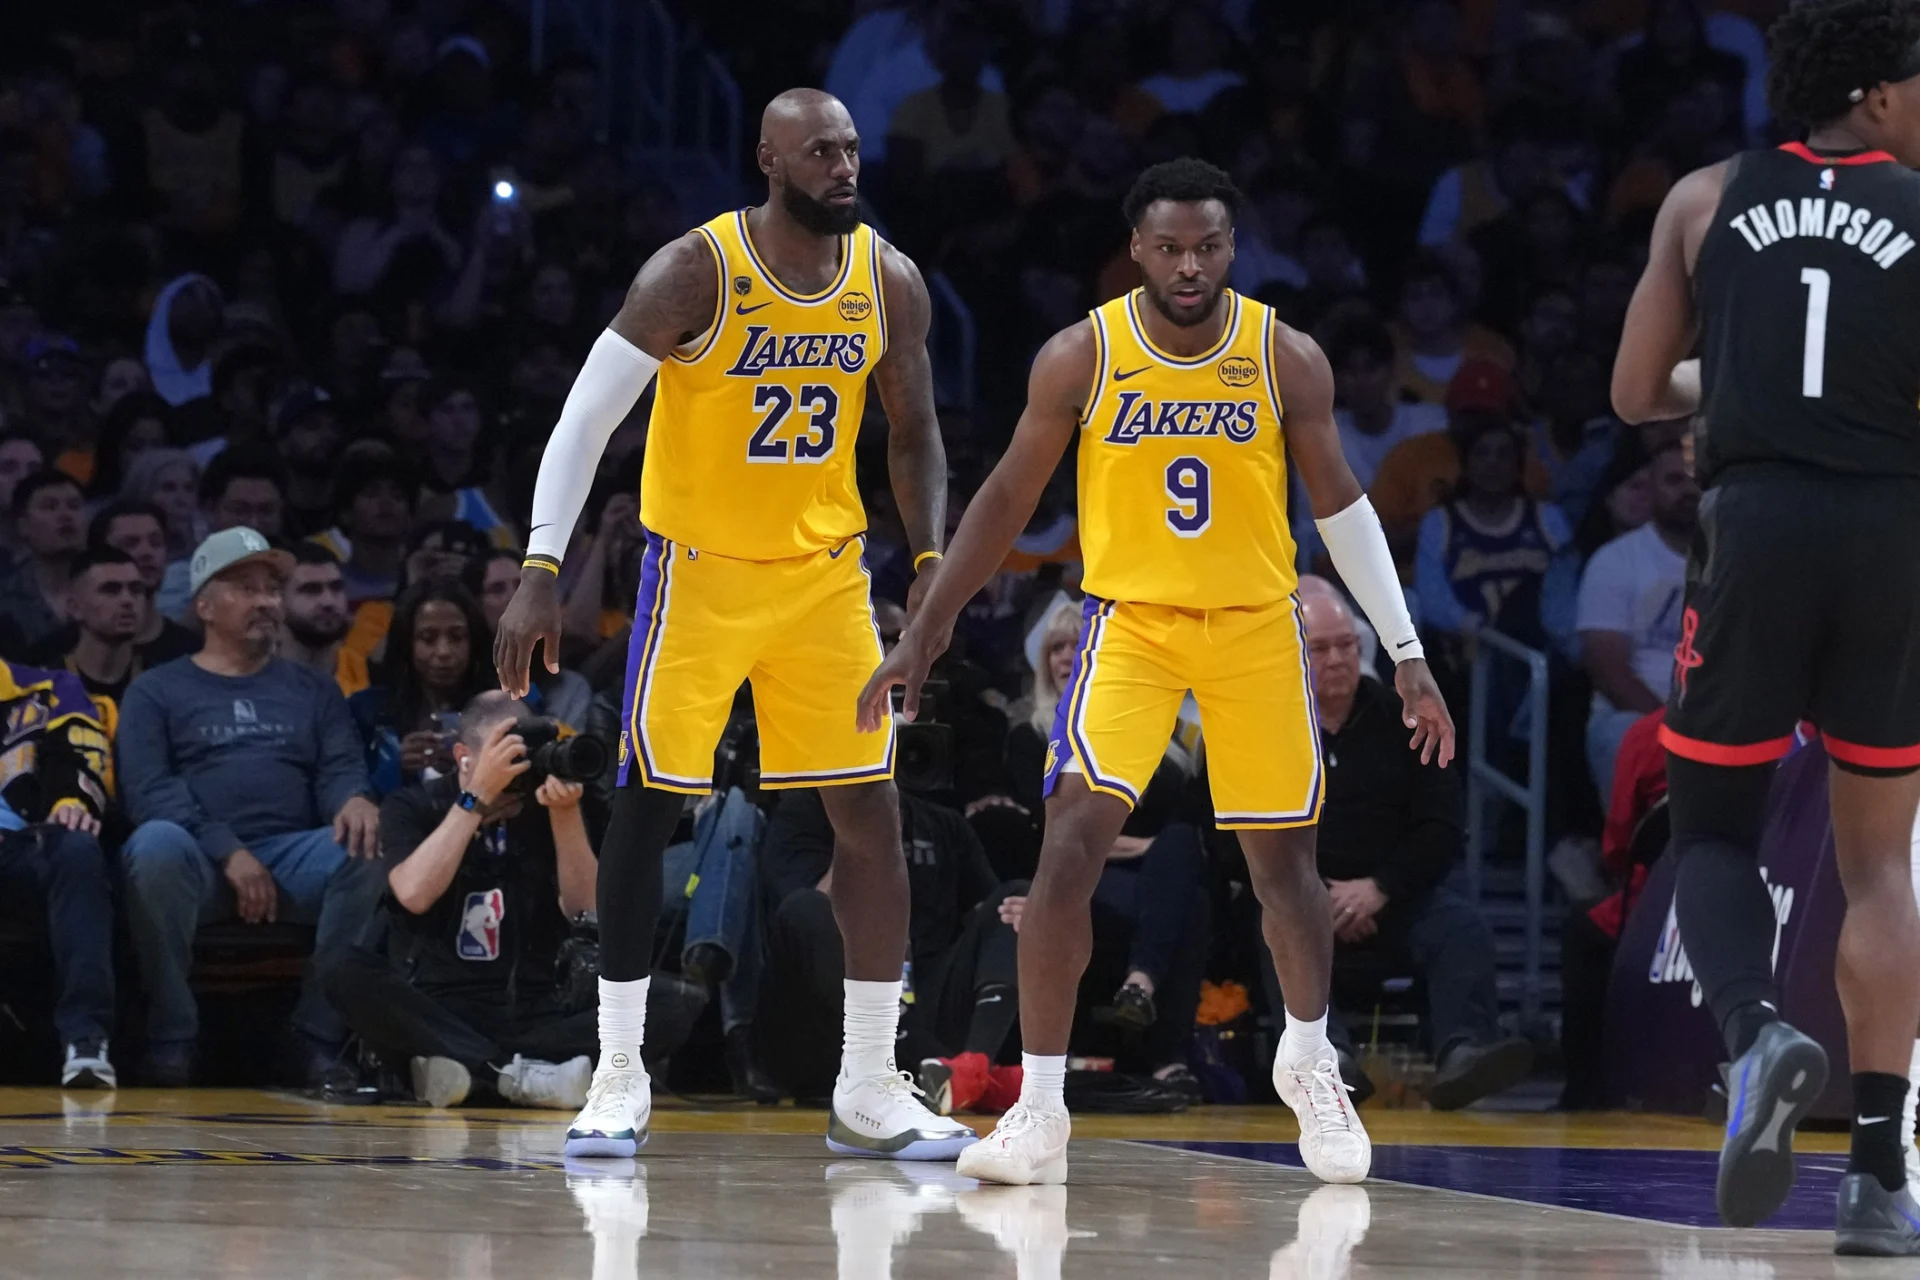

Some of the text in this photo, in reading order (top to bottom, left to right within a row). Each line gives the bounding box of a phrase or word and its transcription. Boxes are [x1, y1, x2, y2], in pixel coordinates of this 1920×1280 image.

[1729, 197, 1917, 270] THOMPSON
[841, 299, 870, 313] bibigo
[1800, 266, 1831, 399] 1
[724, 325, 868, 377] LAKERS
[1221, 364, 1256, 379] bibigo
[746, 384, 840, 464] 23
[1103, 391, 1260, 446] LAKERS
[1164, 456, 1213, 539] 9
